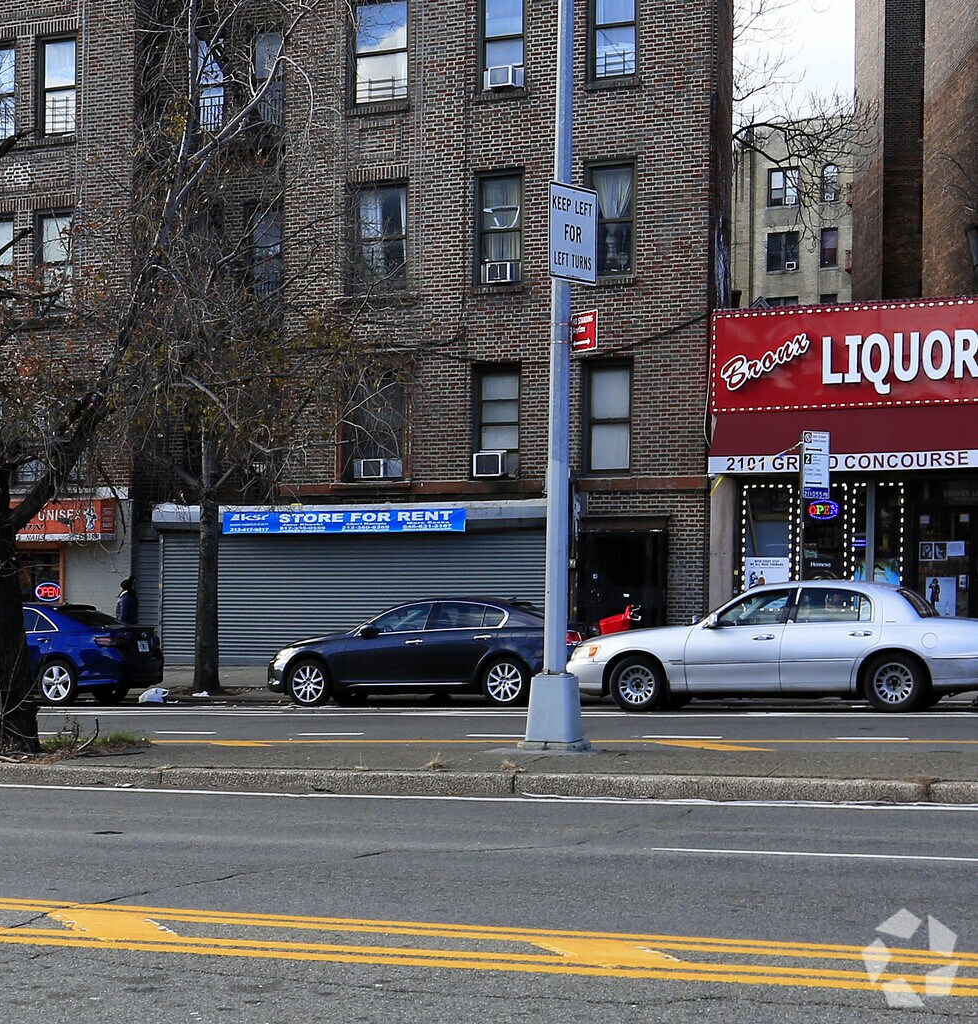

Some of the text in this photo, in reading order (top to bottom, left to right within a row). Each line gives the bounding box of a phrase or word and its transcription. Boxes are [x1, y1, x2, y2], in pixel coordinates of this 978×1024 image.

[552, 195, 592, 217] KEEP LEFT
[565, 224, 581, 243] FOR
[554, 251, 592, 271] LEFT TURNS
[721, 329, 978, 394] Bronx LIQUOR
[727, 456, 766, 471] 2101
[772, 455, 839, 470] GRD
[844, 451, 969, 470] CONCOURSE
[278, 513, 344, 523] STORE
[350, 512, 391, 522] FOR
[397, 510, 453, 522] RENT
[808, 504, 838, 515] OPEN
[36, 586, 60, 597] OPEN
